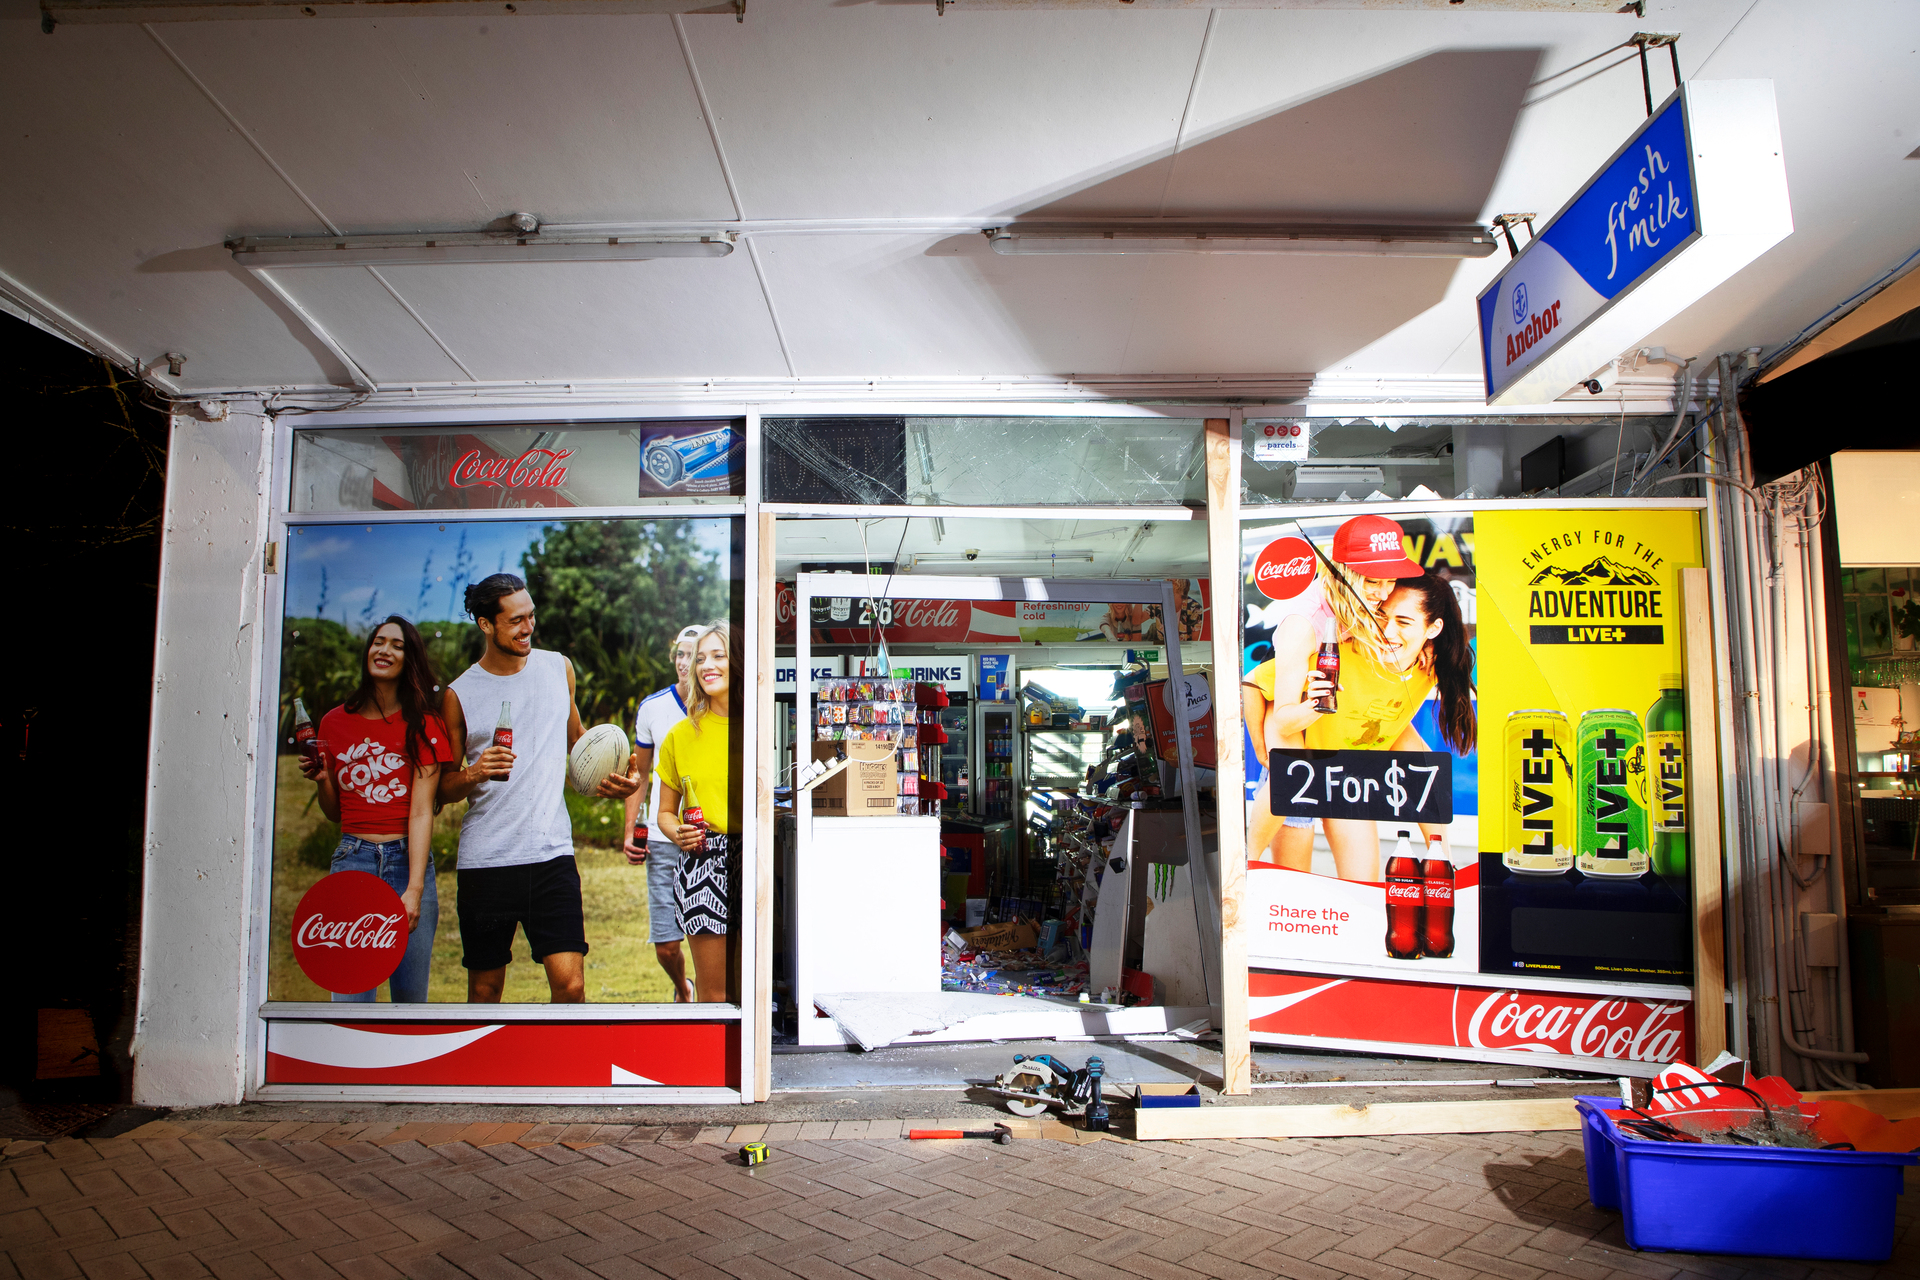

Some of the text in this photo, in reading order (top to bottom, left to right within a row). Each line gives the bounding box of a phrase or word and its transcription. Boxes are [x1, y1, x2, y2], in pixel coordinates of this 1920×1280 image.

[1605, 144, 1669, 280] fresh
[1628, 181, 1688, 252] milk
[1506, 300, 1561, 367] Anchor
[1267, 440, 1297, 450] parcels
[449, 449, 576, 489] Coca-Cola
[1369, 541, 1400, 553] TIMES
[1370, 531, 1398, 543] GOOD
[1522, 530, 1664, 570] ENERGY FOR THE
[1258, 555, 1314, 581] Coca-Cola
[1023, 602, 1090, 611] Refreshingly
[1023, 612, 1045, 620] cold
[1529, 590, 1663, 618] ADVENTURE
[1568, 627, 1626, 642] LIVE+
[776, 668, 832, 682] DRKS
[1858, 699, 1868, 710] A
[1287, 759, 1439, 816] 2 For $7
[1522, 729, 1553, 855] LIVE+
[1596, 729, 1628, 859] LIVE+
[1659, 742, 1685, 828] LIVE+
[1389, 885, 1420, 899] Coca-Cola
[1269, 904, 1350, 921] Share the
[297, 913, 404, 949] Coca-Cola
[1268, 921, 1338, 936] moment
[1468, 988, 1690, 1063] Coca-Cola
